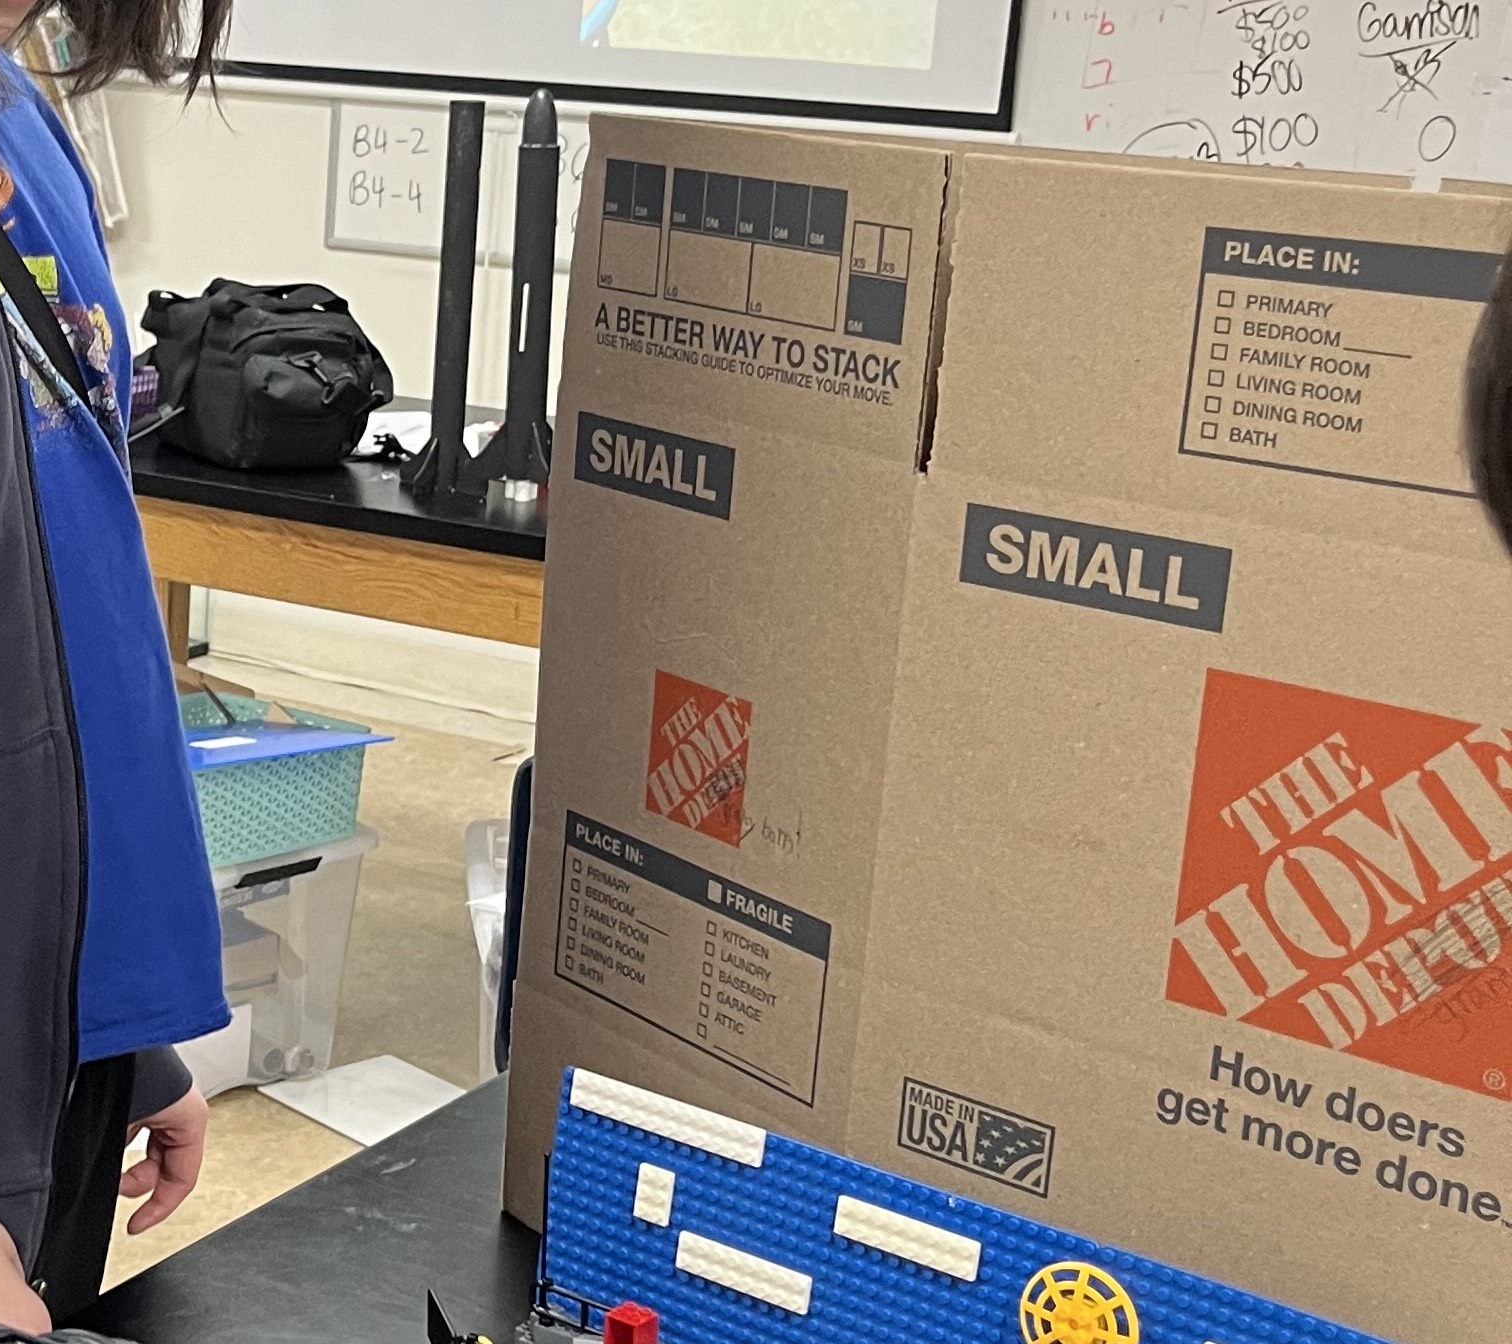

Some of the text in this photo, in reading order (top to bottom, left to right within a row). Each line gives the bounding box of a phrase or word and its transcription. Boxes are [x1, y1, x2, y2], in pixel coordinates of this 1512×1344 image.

[1231, 52, 1303, 100] $500
[352, 123, 429, 159] B4-2
[1231, 112, 1319, 165] $100
[348, 170, 422, 214] B4-4
[1224, 240, 1361, 276] PLACE IN:
[1245, 293, 1334, 320] PRIMARY
[594, 302, 903, 390] A BETTER WAY TO STACK
[1242, 320, 1342, 348] BEDROOM
[596, 331, 894, 407] USE THIS STACKING GUIDE TO OPTIMIZE YOUR MOVE.
[1238, 347, 1371, 379] FAMILY ROOM
[1236, 372, 1363, 406] LIVING ROOM
[1232, 400, 1363, 434] DINING ROOM
[1228, 427, 1278, 449] BATH
[589, 428, 718, 502] SMALL
[984, 522, 1201, 611] SMALL
[659, 695, 704, 748] THE
[647, 694, 751, 817] HOME
[1219, 731, 1376, 857] THE
[575, 822, 645, 867] PLACE IN:
[587, 865, 631, 895] PRIMARY
[1172, 724, 1512, 1021] HOME
[584, 885, 636, 917] BEDROOM
[726, 889, 794, 935] FRAGILE
[582, 924, 646, 965] LIVING ROOM
[583, 904, 650, 946] FAMILY ROOM
[722, 928, 770, 961] KITCHEN
[578, 963, 604, 985] BATH
[580, 943, 646, 986] DINING ROOM
[720, 948, 772, 983] LAUNDRY
[716, 990, 763, 1023] GARAGE
[718, 969, 778, 1006] BASEMENT
[714, 1010, 745, 1036] ATTIC
[908, 1086, 976, 1124] MADE IN
[1209, 1044, 1467, 1160] How doers
[906, 1103, 970, 1163] USA
[1156, 1086, 1230, 1135] get
[1241, 1111, 1363, 1177] more
